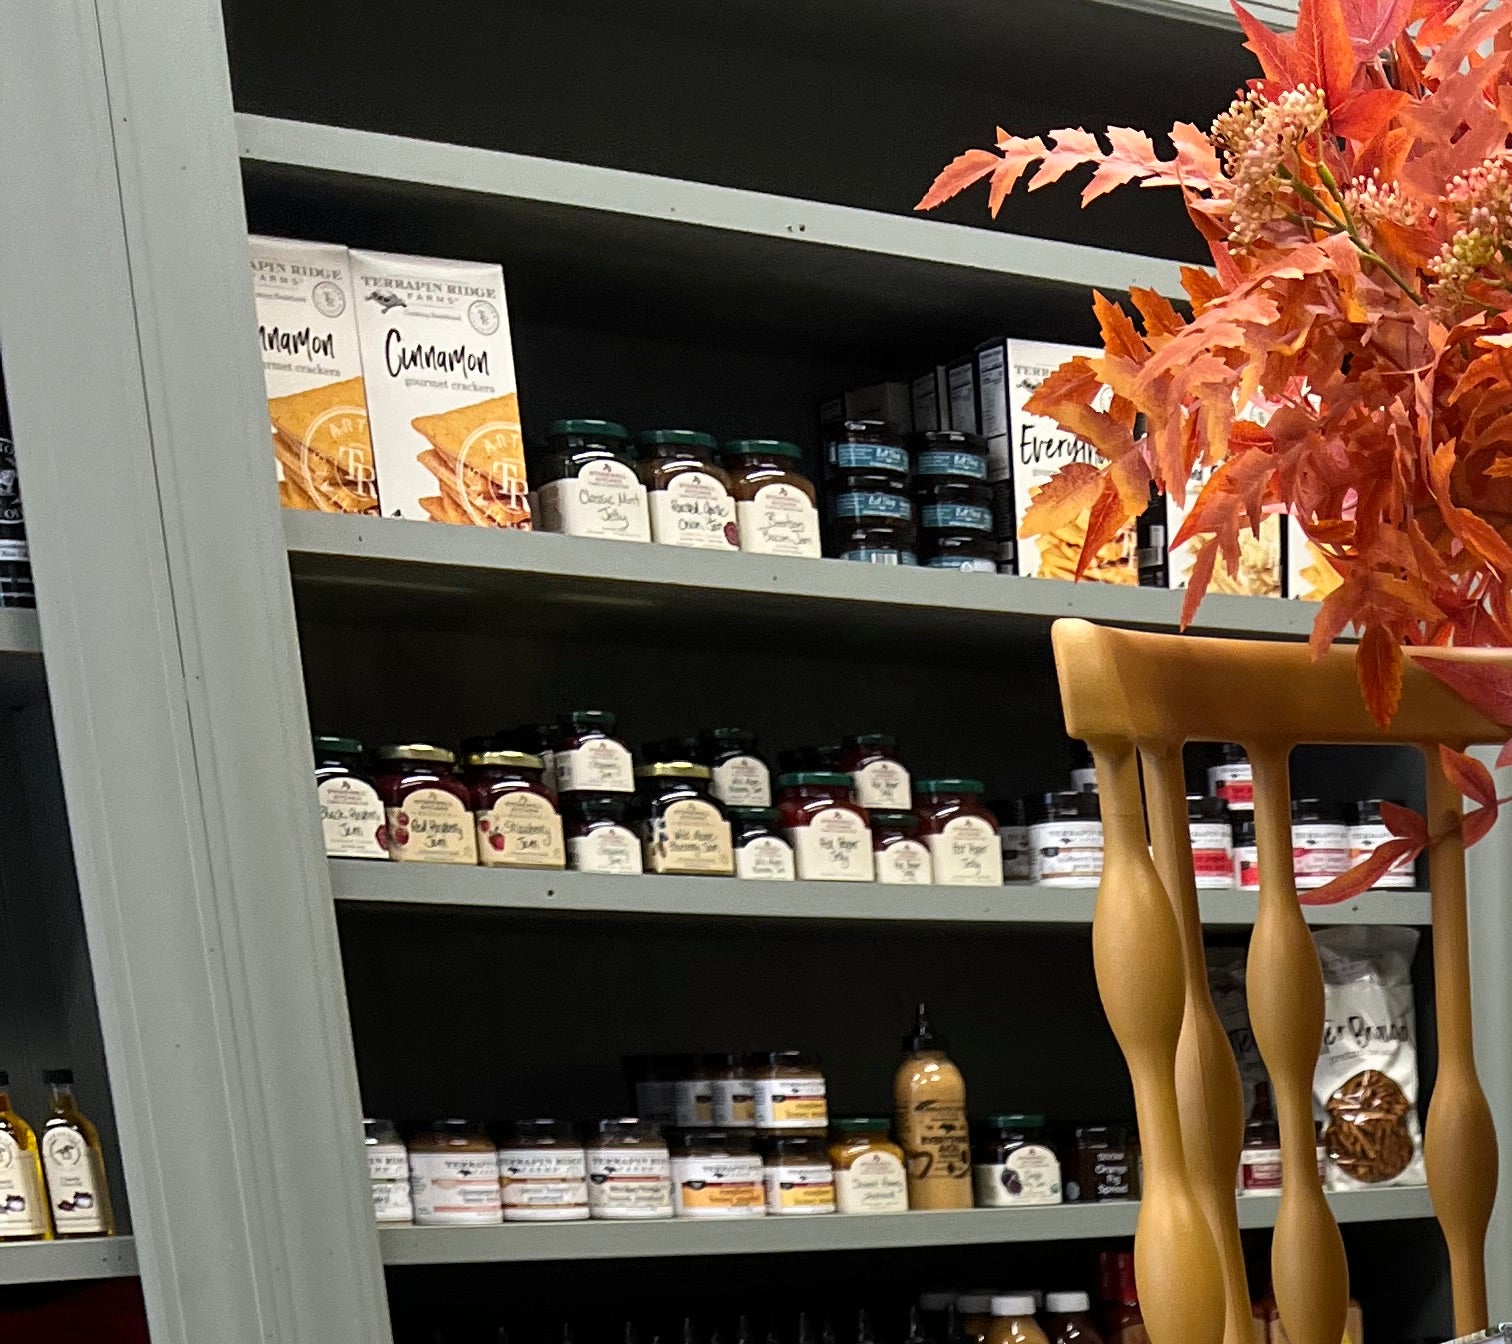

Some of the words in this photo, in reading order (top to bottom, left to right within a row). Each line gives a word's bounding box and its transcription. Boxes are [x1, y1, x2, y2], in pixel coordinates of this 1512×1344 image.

[361, 276, 442, 293] TERRAPIN
[447, 284, 496, 299] RIDGE
[385, 328, 491, 379] Cinnamon
[264, 361, 293, 373] rmet
[295, 362, 341, 377] crackers
[405, 378, 449, 390] gourmet
[451, 380, 496, 393] crackers
